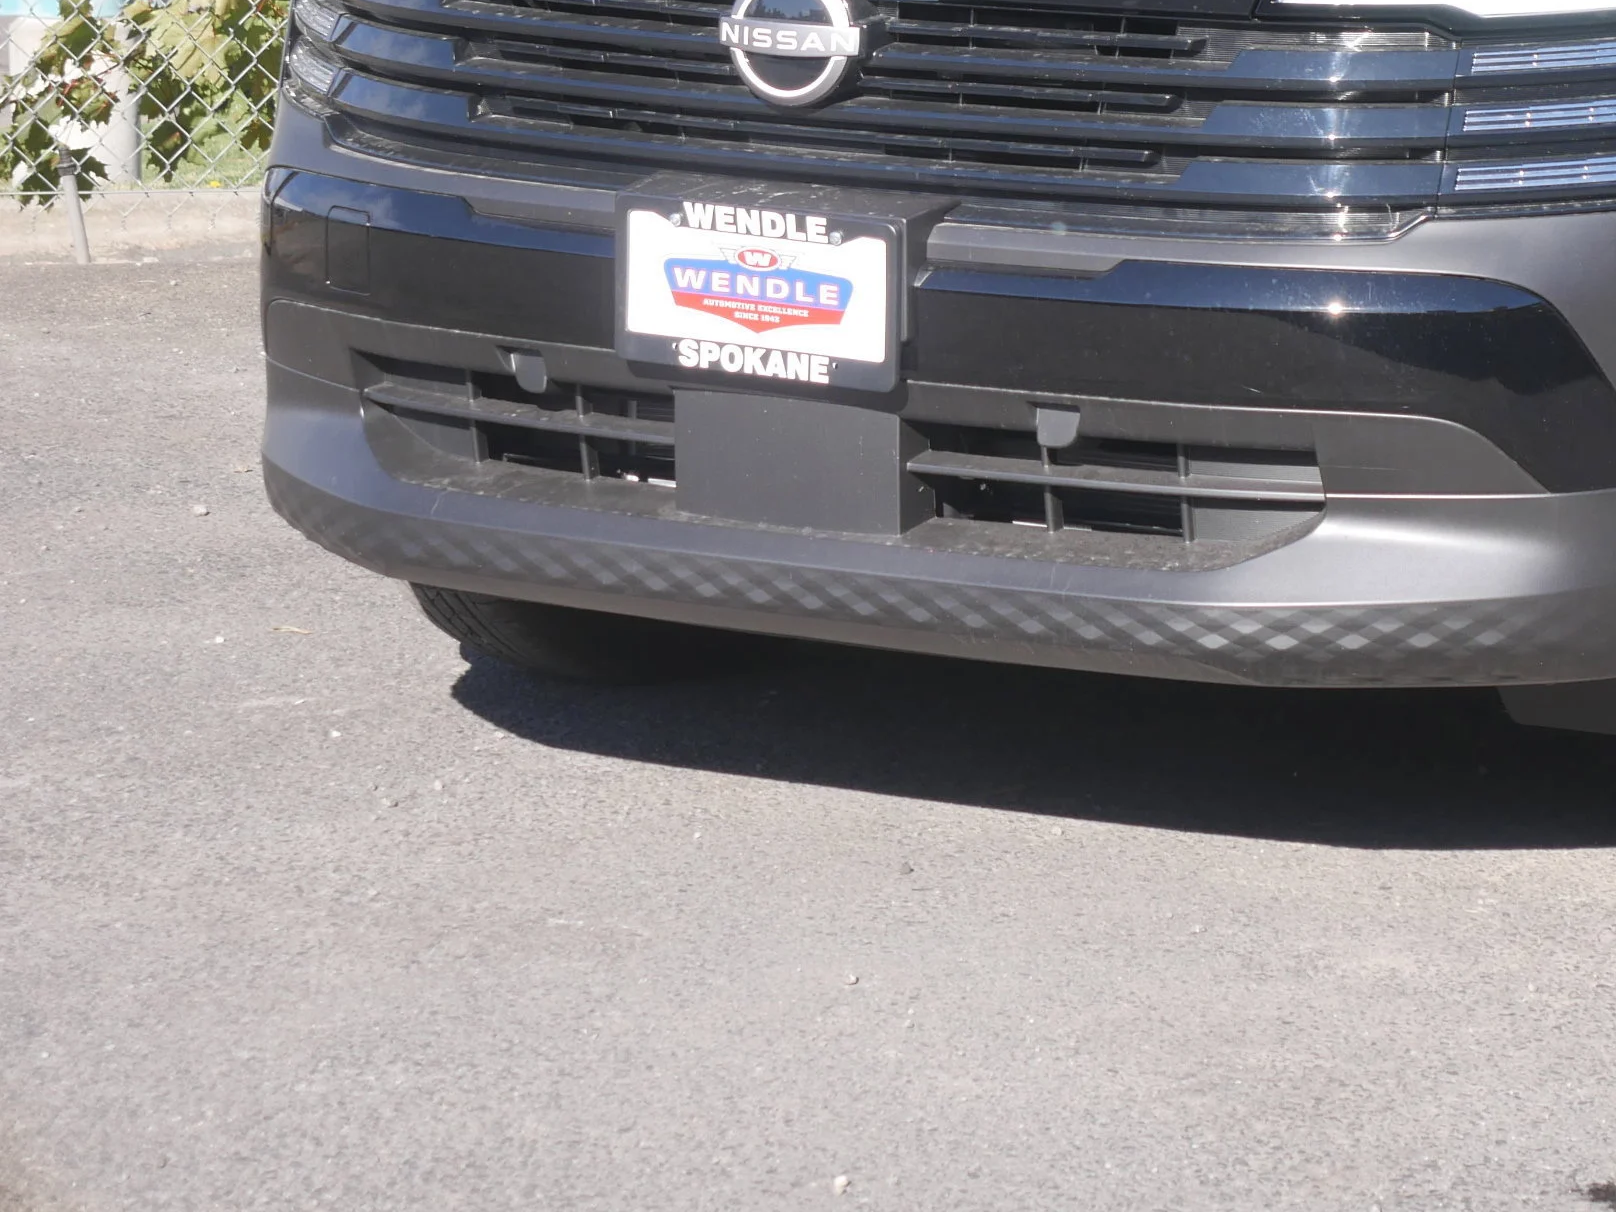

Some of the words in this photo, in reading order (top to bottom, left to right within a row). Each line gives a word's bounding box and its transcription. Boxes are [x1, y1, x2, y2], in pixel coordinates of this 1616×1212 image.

[721, 21, 856, 52] NISSAN
[682, 201, 829, 244] WENDLE
[743, 251, 772, 267] W
[673, 266, 839, 306] WENDLE
[703, 298, 756, 311] AUTOMOTIVE
[757, 304, 809, 318] EXCELLENCE
[734, 311, 759, 321] SINCE
[677, 338, 830, 385] SPOKANE
